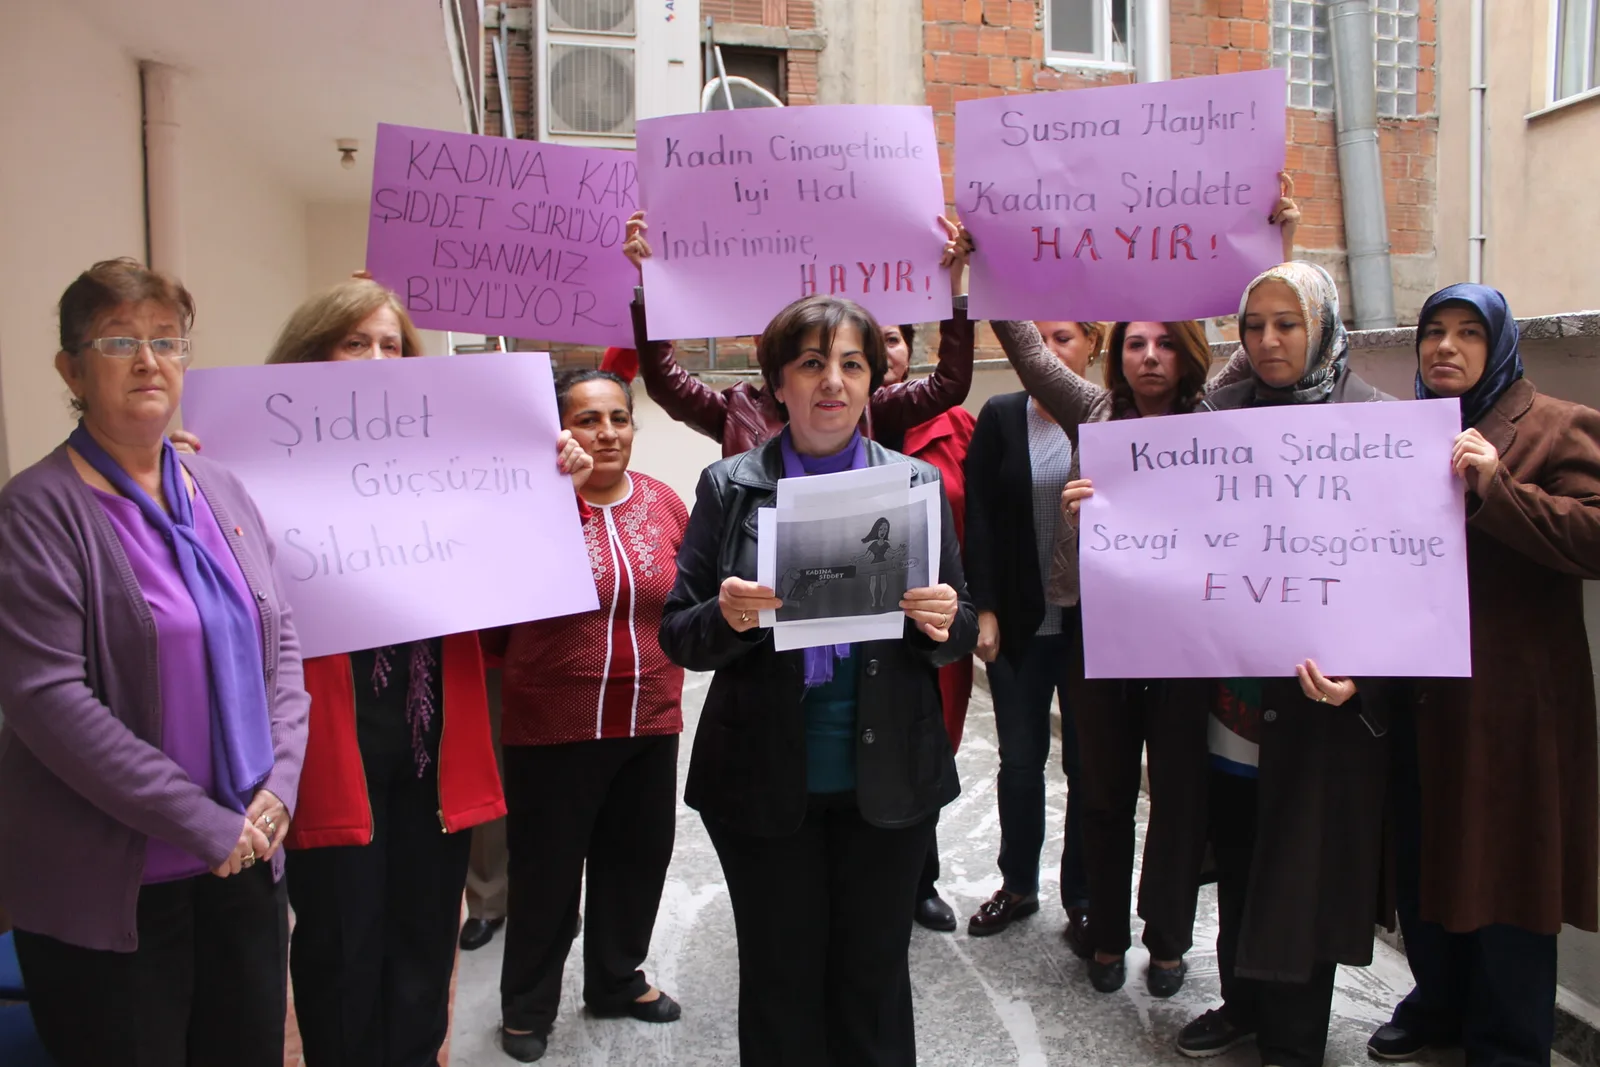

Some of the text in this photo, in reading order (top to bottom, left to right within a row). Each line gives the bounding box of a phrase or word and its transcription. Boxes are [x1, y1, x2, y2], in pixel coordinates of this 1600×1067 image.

[1001, 111, 1120, 147] Susma
[665, 132, 924, 171] Kadın Cinayetinde
[407, 140, 639, 209] KADINA KAR
[798, 171, 857, 203] Hal
[968, 170, 1252, 214] Kadına Şiddete
[506, 200, 625, 249] SÜRÜYO
[265, 390, 433, 457] Şiddet
[1131, 433, 1415, 472] Kadına Şiddete
[1215, 474, 1351, 502] HAYIR
[1091, 523, 1445, 566] Sevgi ve Hoşgörüye
[1202, 572, 1341, 606] EVET
